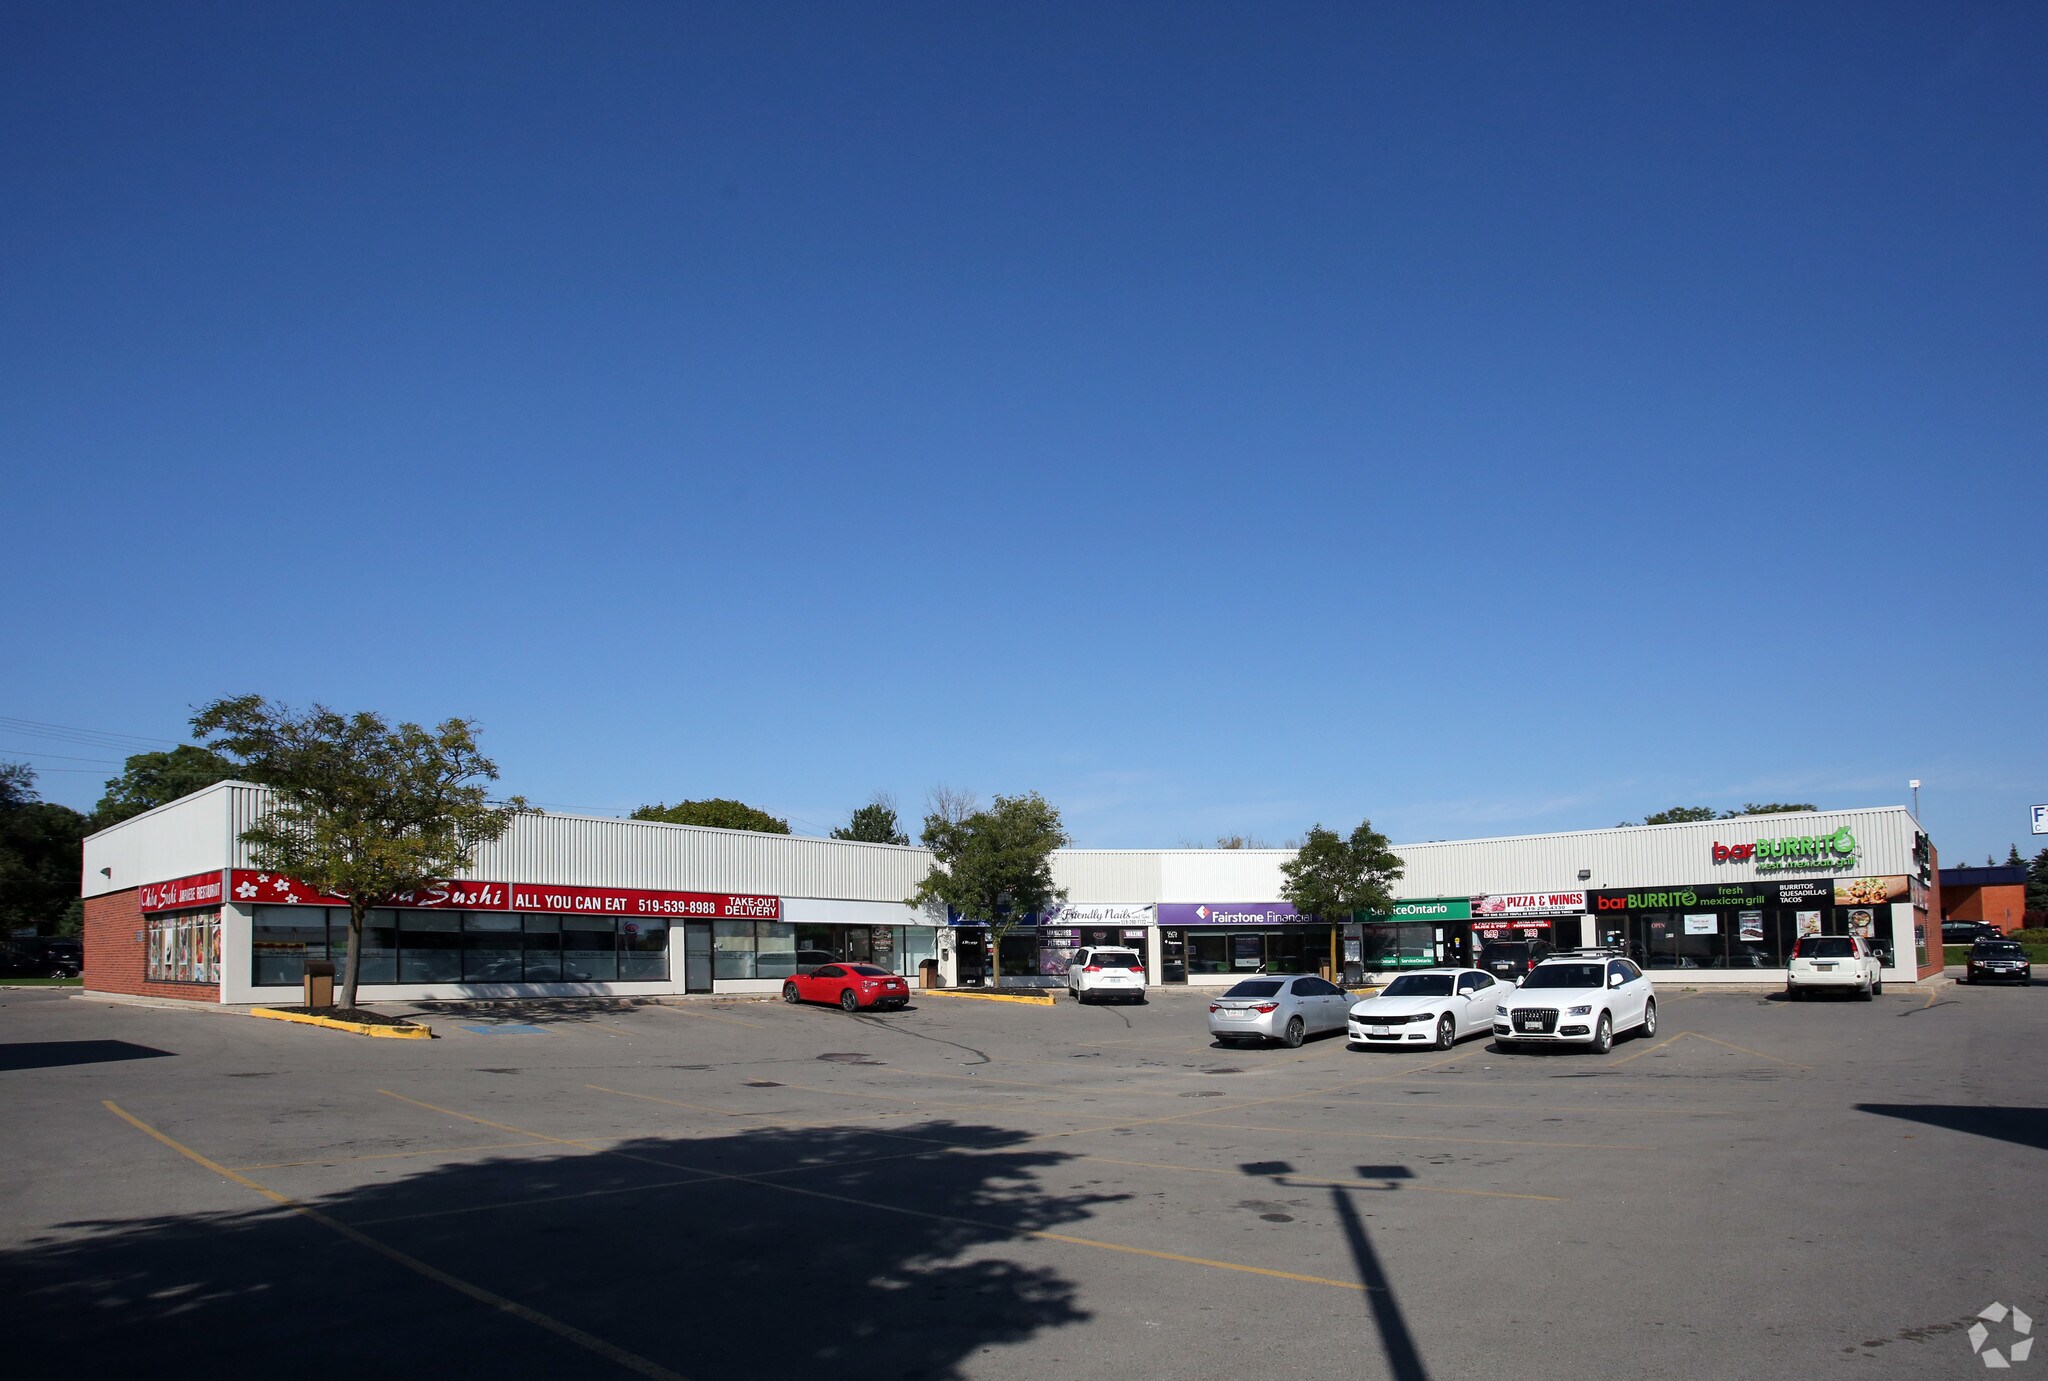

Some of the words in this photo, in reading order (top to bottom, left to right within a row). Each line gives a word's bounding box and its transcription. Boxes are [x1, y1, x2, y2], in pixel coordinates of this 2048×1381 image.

[1713, 829, 1855, 860] barBURRITO
[1758, 861, 1781, 869] fresh
[1786, 859, 1832, 868] mexican
[1834, 856, 1855, 868] grill
[417, 881, 502, 906] Sushi
[1718, 886, 1743, 895] fresh
[1779, 883, 1814, 891] BURRITOS
[1779, 889, 1827, 897] QUESADILLAS
[157, 884, 177, 909] Sushi
[515, 894, 541, 908] ALL
[545, 895, 572, 909] YOU
[575, 896, 601, 911] CAN
[605, 898, 628, 911] EAT
[729, 896, 777, 907] TAKE-OUT
[1507, 896, 1536, 908] PIZZA
[1539, 895, 1545, 906] &
[1548, 893, 1583, 905] WINGS
[1598, 889, 1697, 910] barBURRITO
[1700, 896, 1744, 906] mexican
[1745, 895, 1765, 907] grill
[638, 899, 716, 914] 519-539-8988
[725, 905, 777, 916] DELIVERY
[1061, 908, 1103, 922] Friendly
[1105, 908, 1131, 920] Nails
[1212, 911, 1264, 923] Fairstone
[1266, 911, 1313, 923] Financial
